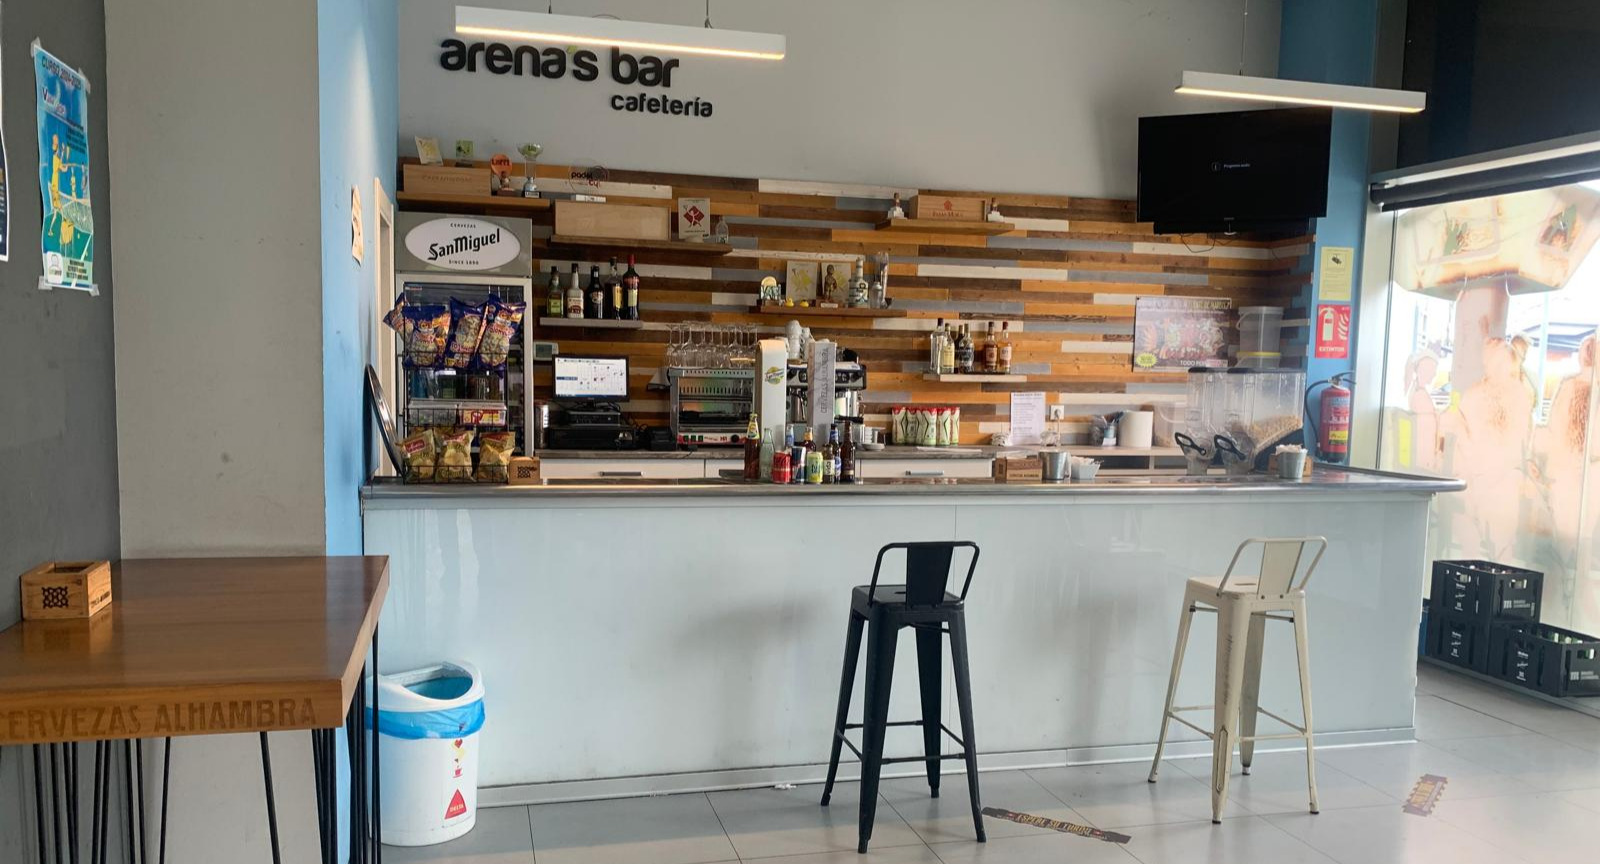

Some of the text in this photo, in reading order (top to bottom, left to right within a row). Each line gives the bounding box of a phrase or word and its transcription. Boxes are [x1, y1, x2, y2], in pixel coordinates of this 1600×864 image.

[439, 38, 680, 88] arena's bar
[610, 92, 713, 118] cafetería
[153, 697, 317, 732] ALHAMBRA
